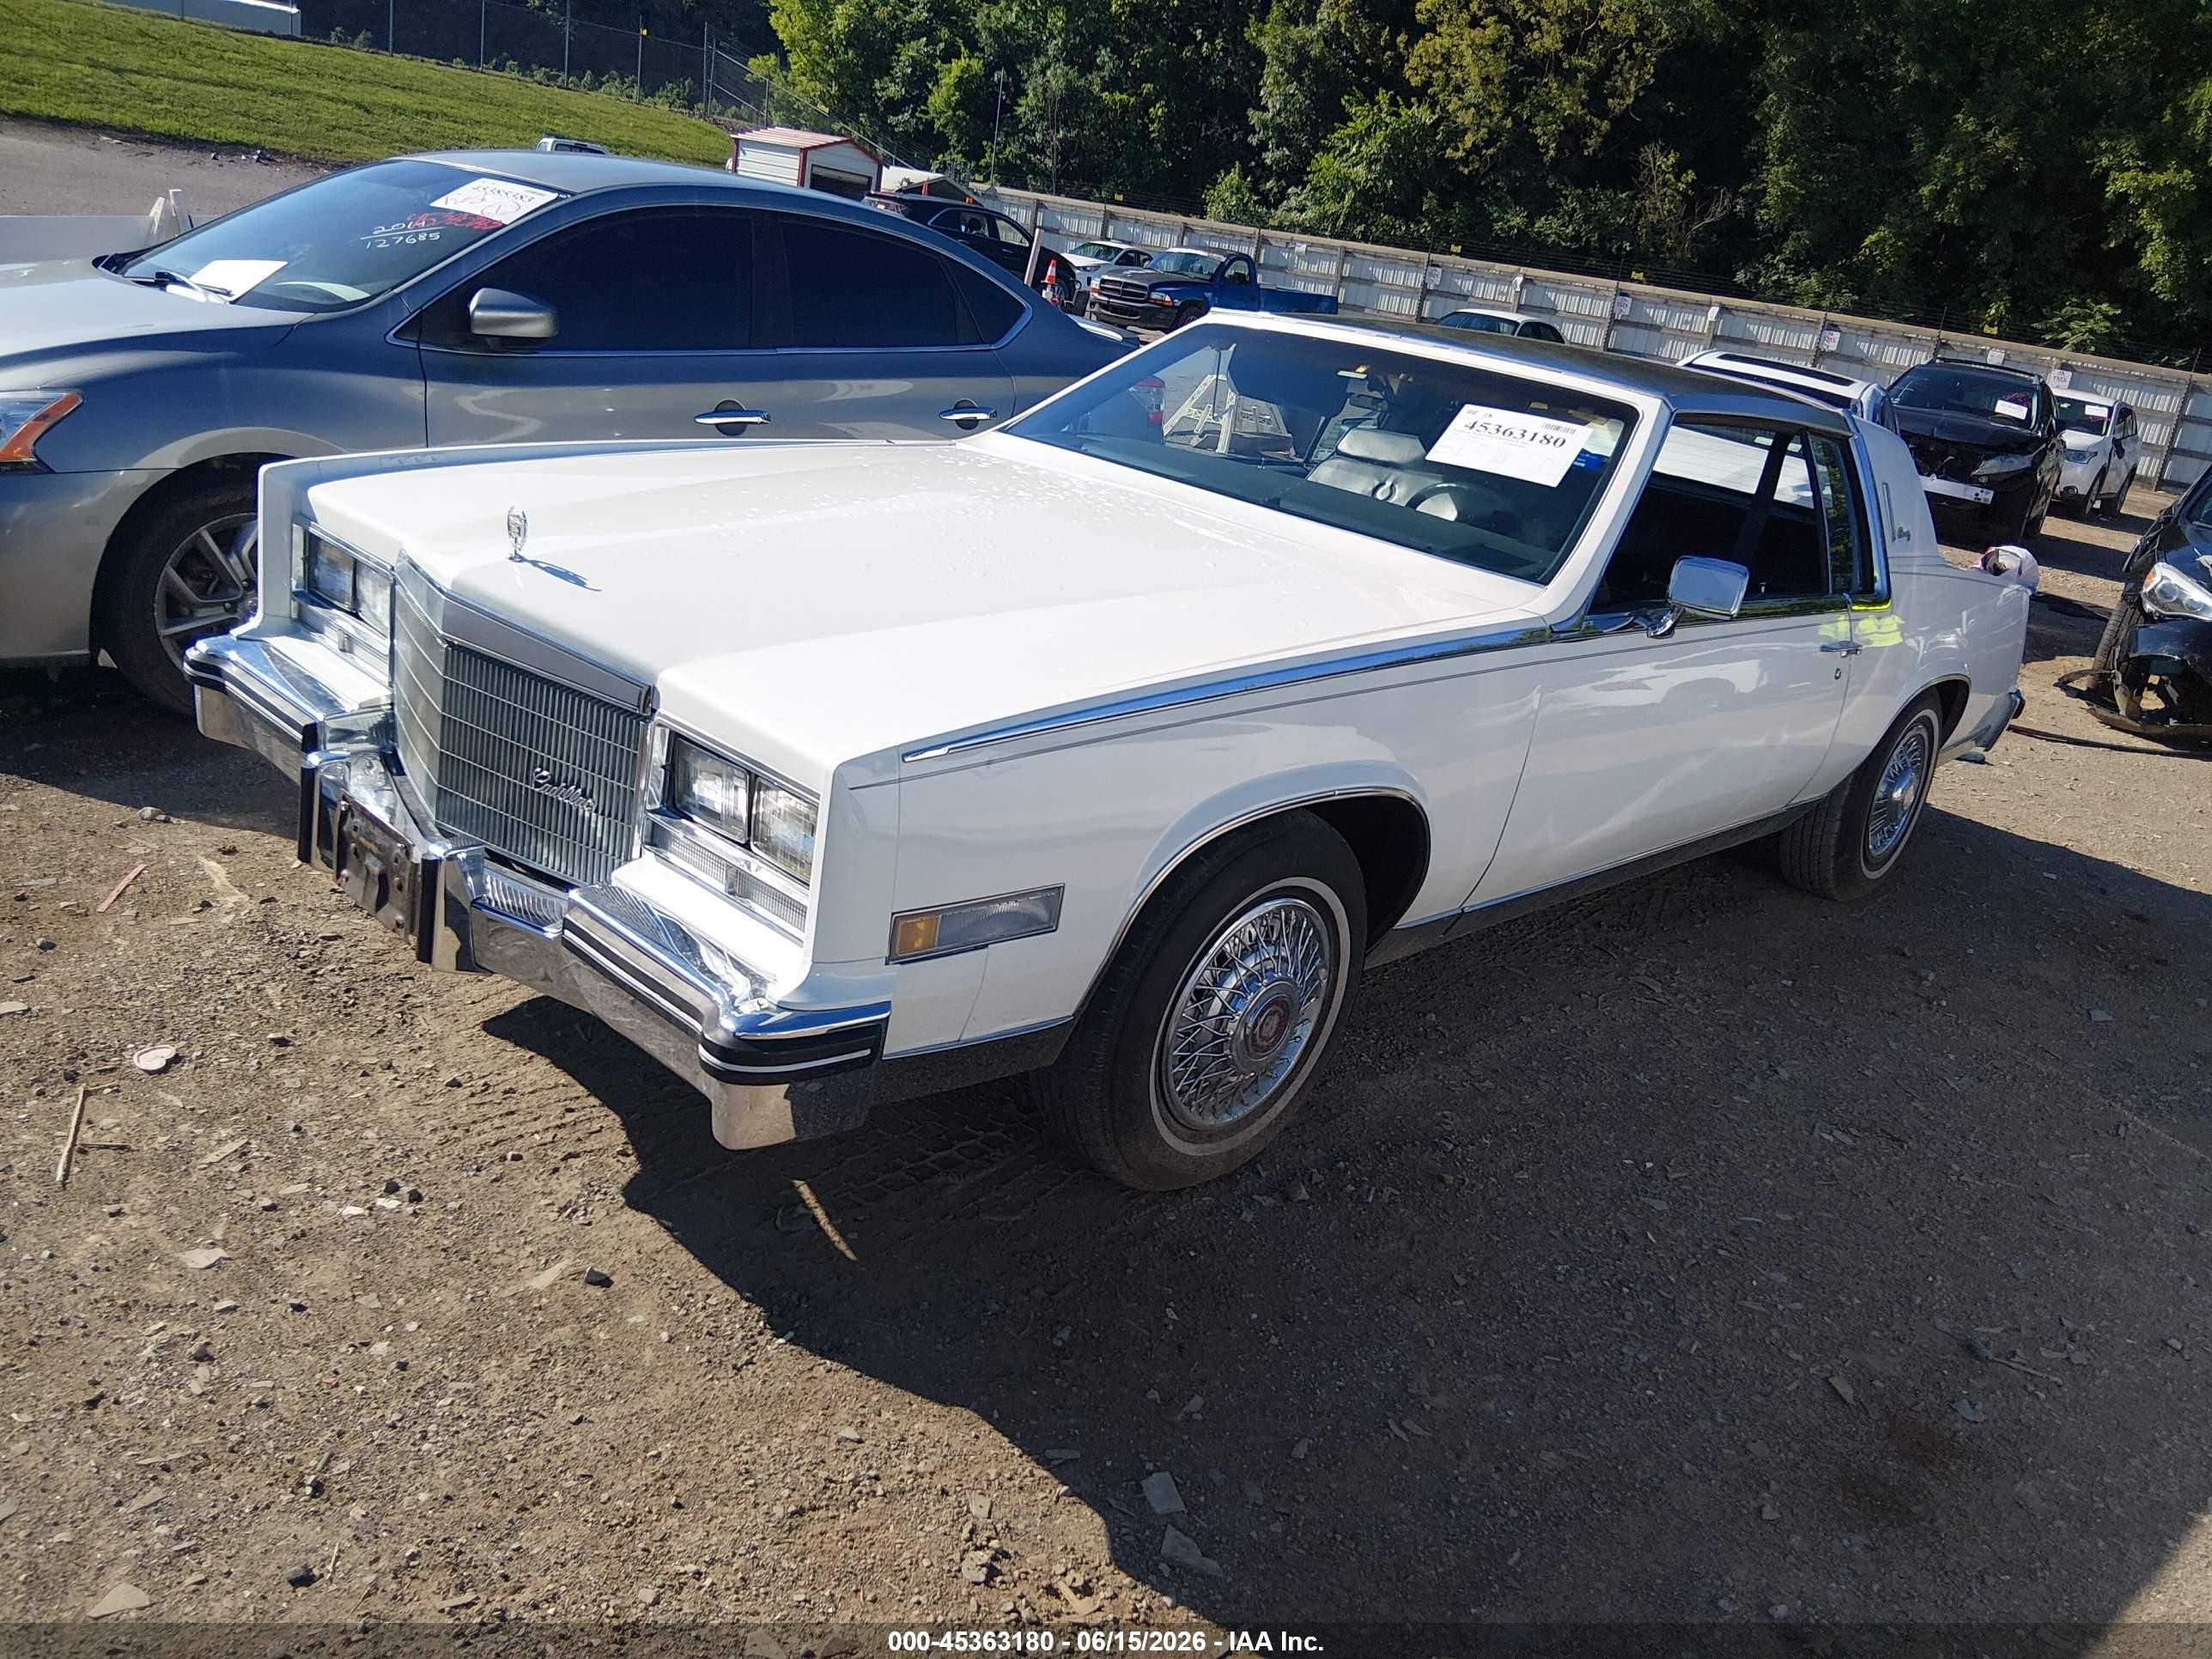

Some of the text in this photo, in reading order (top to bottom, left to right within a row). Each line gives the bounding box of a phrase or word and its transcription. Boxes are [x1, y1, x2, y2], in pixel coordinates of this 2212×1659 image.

[366, 232, 441, 249] 127685
[1464, 420, 1566, 447] 45363180
[532, 767, 596, 814] Cadillac
